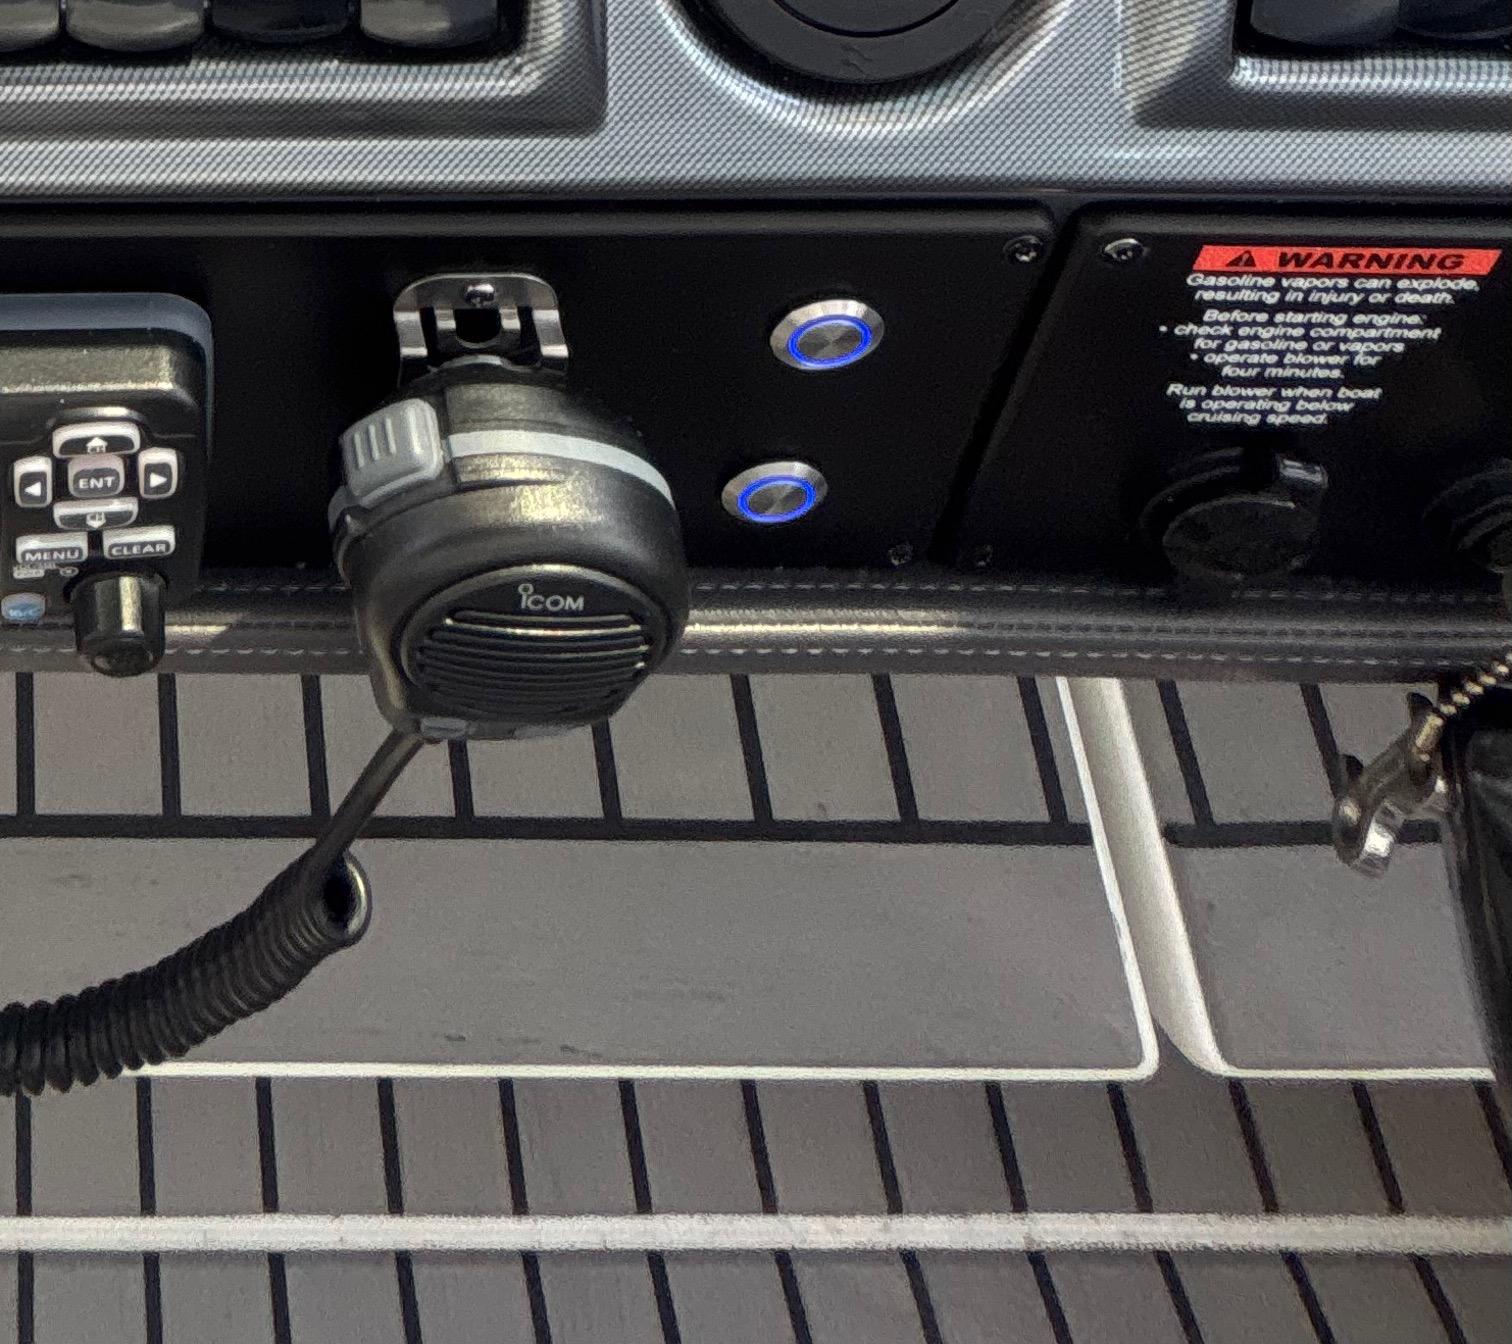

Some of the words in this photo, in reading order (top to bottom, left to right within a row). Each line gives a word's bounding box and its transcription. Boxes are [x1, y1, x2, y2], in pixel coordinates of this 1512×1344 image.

[1279, 252, 1464, 270] WARNING
[1186, 273, 1276, 286] Gasoline
[1281, 276, 1349, 289] vapors
[1354, 277, 1392, 289] can
[1194, 289, 1281, 304] resulting
[1285, 289, 1304, 302] in
[1308, 290, 1365, 306] injury
[1368, 292, 1392, 303] or
[1394, 291, 1455, 304] death.
[1203, 309, 1269, 323] Before
[1273, 310, 1348, 326] starting
[1174, 322, 1234, 336] check
[1238, 324, 1306, 338] engine
[1309, 326, 1442, 340] compartment
[1194, 337, 1223, 350] for
[1224, 338, 1308, 352] gasoline
[1312, 340, 1336, 351] or
[1339, 341, 1405, 354] vapors
[1203, 352, 1279, 365] operate
[1283, 352, 1350, 365] blower
[1353, 352, 1383, 366] for
[1221, 365, 1261, 377] four
[1264, 366, 1345, 378] minutes.
[1166, 383, 1207, 396] Run
[1211, 384, 1277, 397] blower
[1281, 385, 1333, 398] when
[1337, 386, 1383, 399] boat
[1179, 398, 1196, 409] is
[1201, 399, 1292, 412] operating
[1295, 399, 1356, 412] below
[1187, 412, 1261, 426] cruising
[78, 476, 116, 490] ENT
[25, 549, 80, 562] MENU
[111, 543, 166, 556] CLEAR
